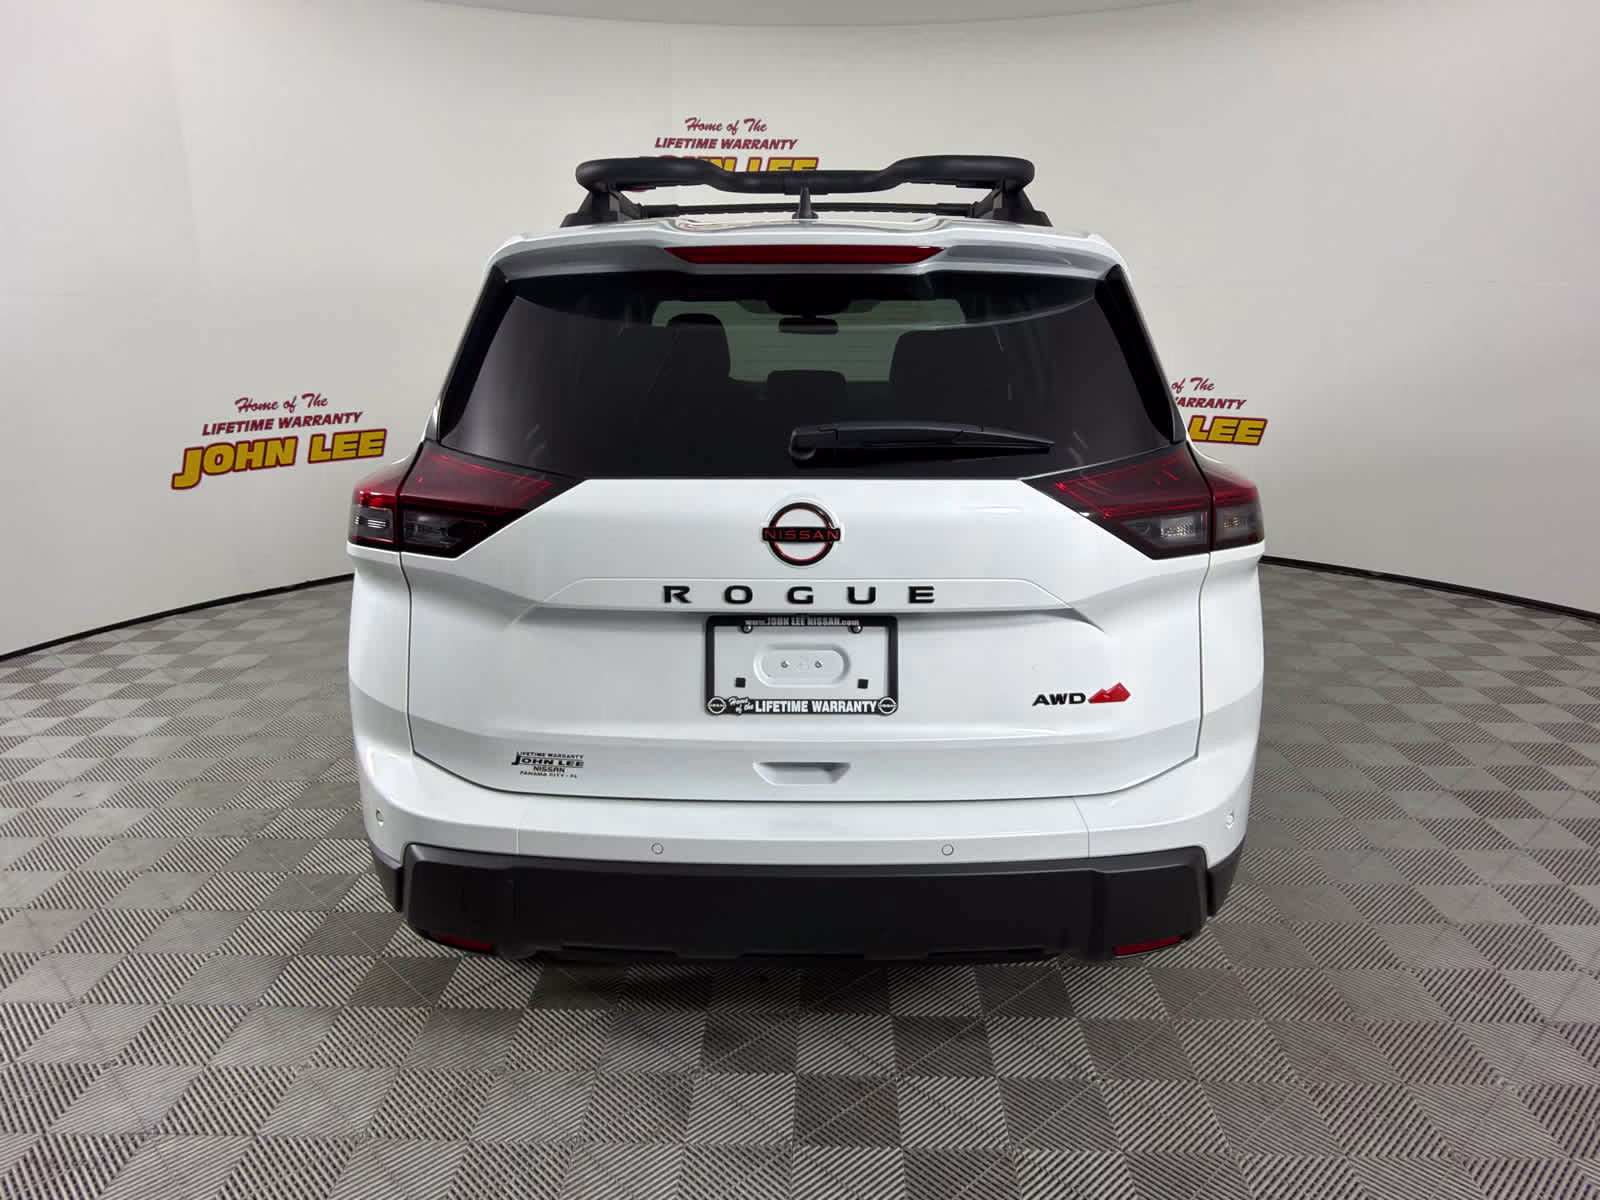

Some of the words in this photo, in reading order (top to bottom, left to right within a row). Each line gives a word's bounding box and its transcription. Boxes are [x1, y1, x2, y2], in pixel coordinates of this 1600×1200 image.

[685, 117, 723, 132] Home
[726, 120, 740, 135] of
[744, 118, 767, 132] The
[655, 138, 718, 149] LIFETIME
[721, 139, 798, 150] WARRANTY
[1171, 378, 1186, 394] of
[1190, 377, 1216, 391] The
[235, 397, 279, 413] Home
[283, 396, 298, 412] of
[301, 393, 328, 408] The
[1174, 396, 1247, 410] ARRANTY
[202, 418, 274, 436] LIFETIME
[278, 412, 363, 428] WARRANTY
[1187, 415, 1269, 446] LEE
[171, 436, 298, 489] JOHN
[307, 429, 387, 463] LEE
[764, 529, 841, 540] NISSAN
[662, 584, 936, 605] ROGUE
[755, 700, 809, 713] LIFETIME
[811, 700, 877, 713] WARRANTY
[1032, 692, 1086, 707] AWD
[511, 752, 554, 766] JOHN
[558, 759, 585, 768] LEE
